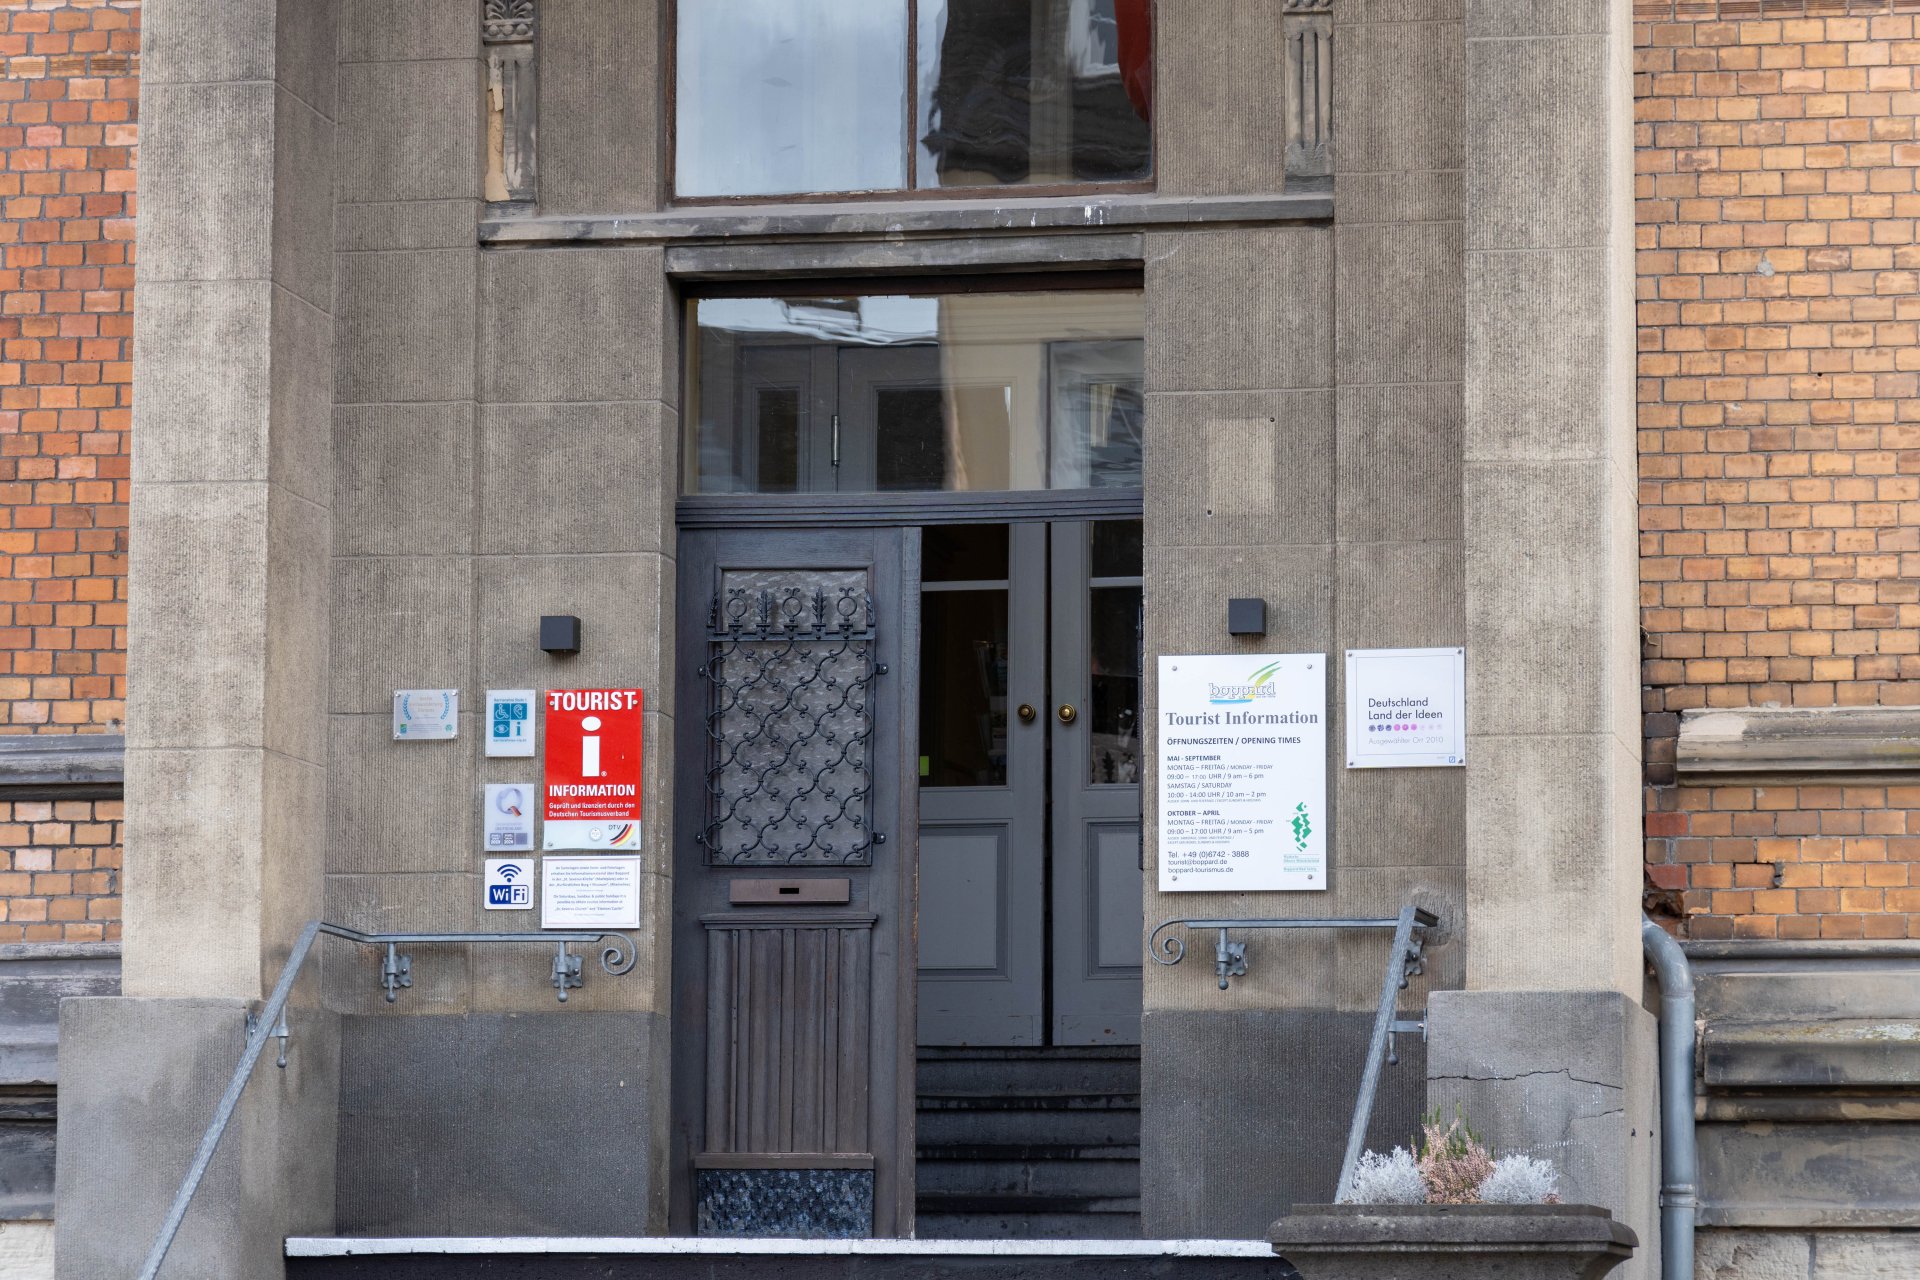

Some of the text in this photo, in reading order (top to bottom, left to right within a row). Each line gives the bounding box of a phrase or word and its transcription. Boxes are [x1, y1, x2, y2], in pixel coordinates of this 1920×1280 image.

[1208, 682, 1276, 699] boppard
[550, 692, 636, 711] TOURIST
[1368, 697, 1429, 708] Deutschland
[1166, 711, 1318, 725] Tourist Information
[1368, 710, 1443, 720] Land der Ideen
[1167, 737, 1234, 745] ÖFFNUNGSZEITEN
[1235, 737, 1240, 745] /
[1368, 737, 1410, 746] Ausgewählter
[549, 784, 635, 797] INFORMATION
[492, 888, 525, 901] WiFi
